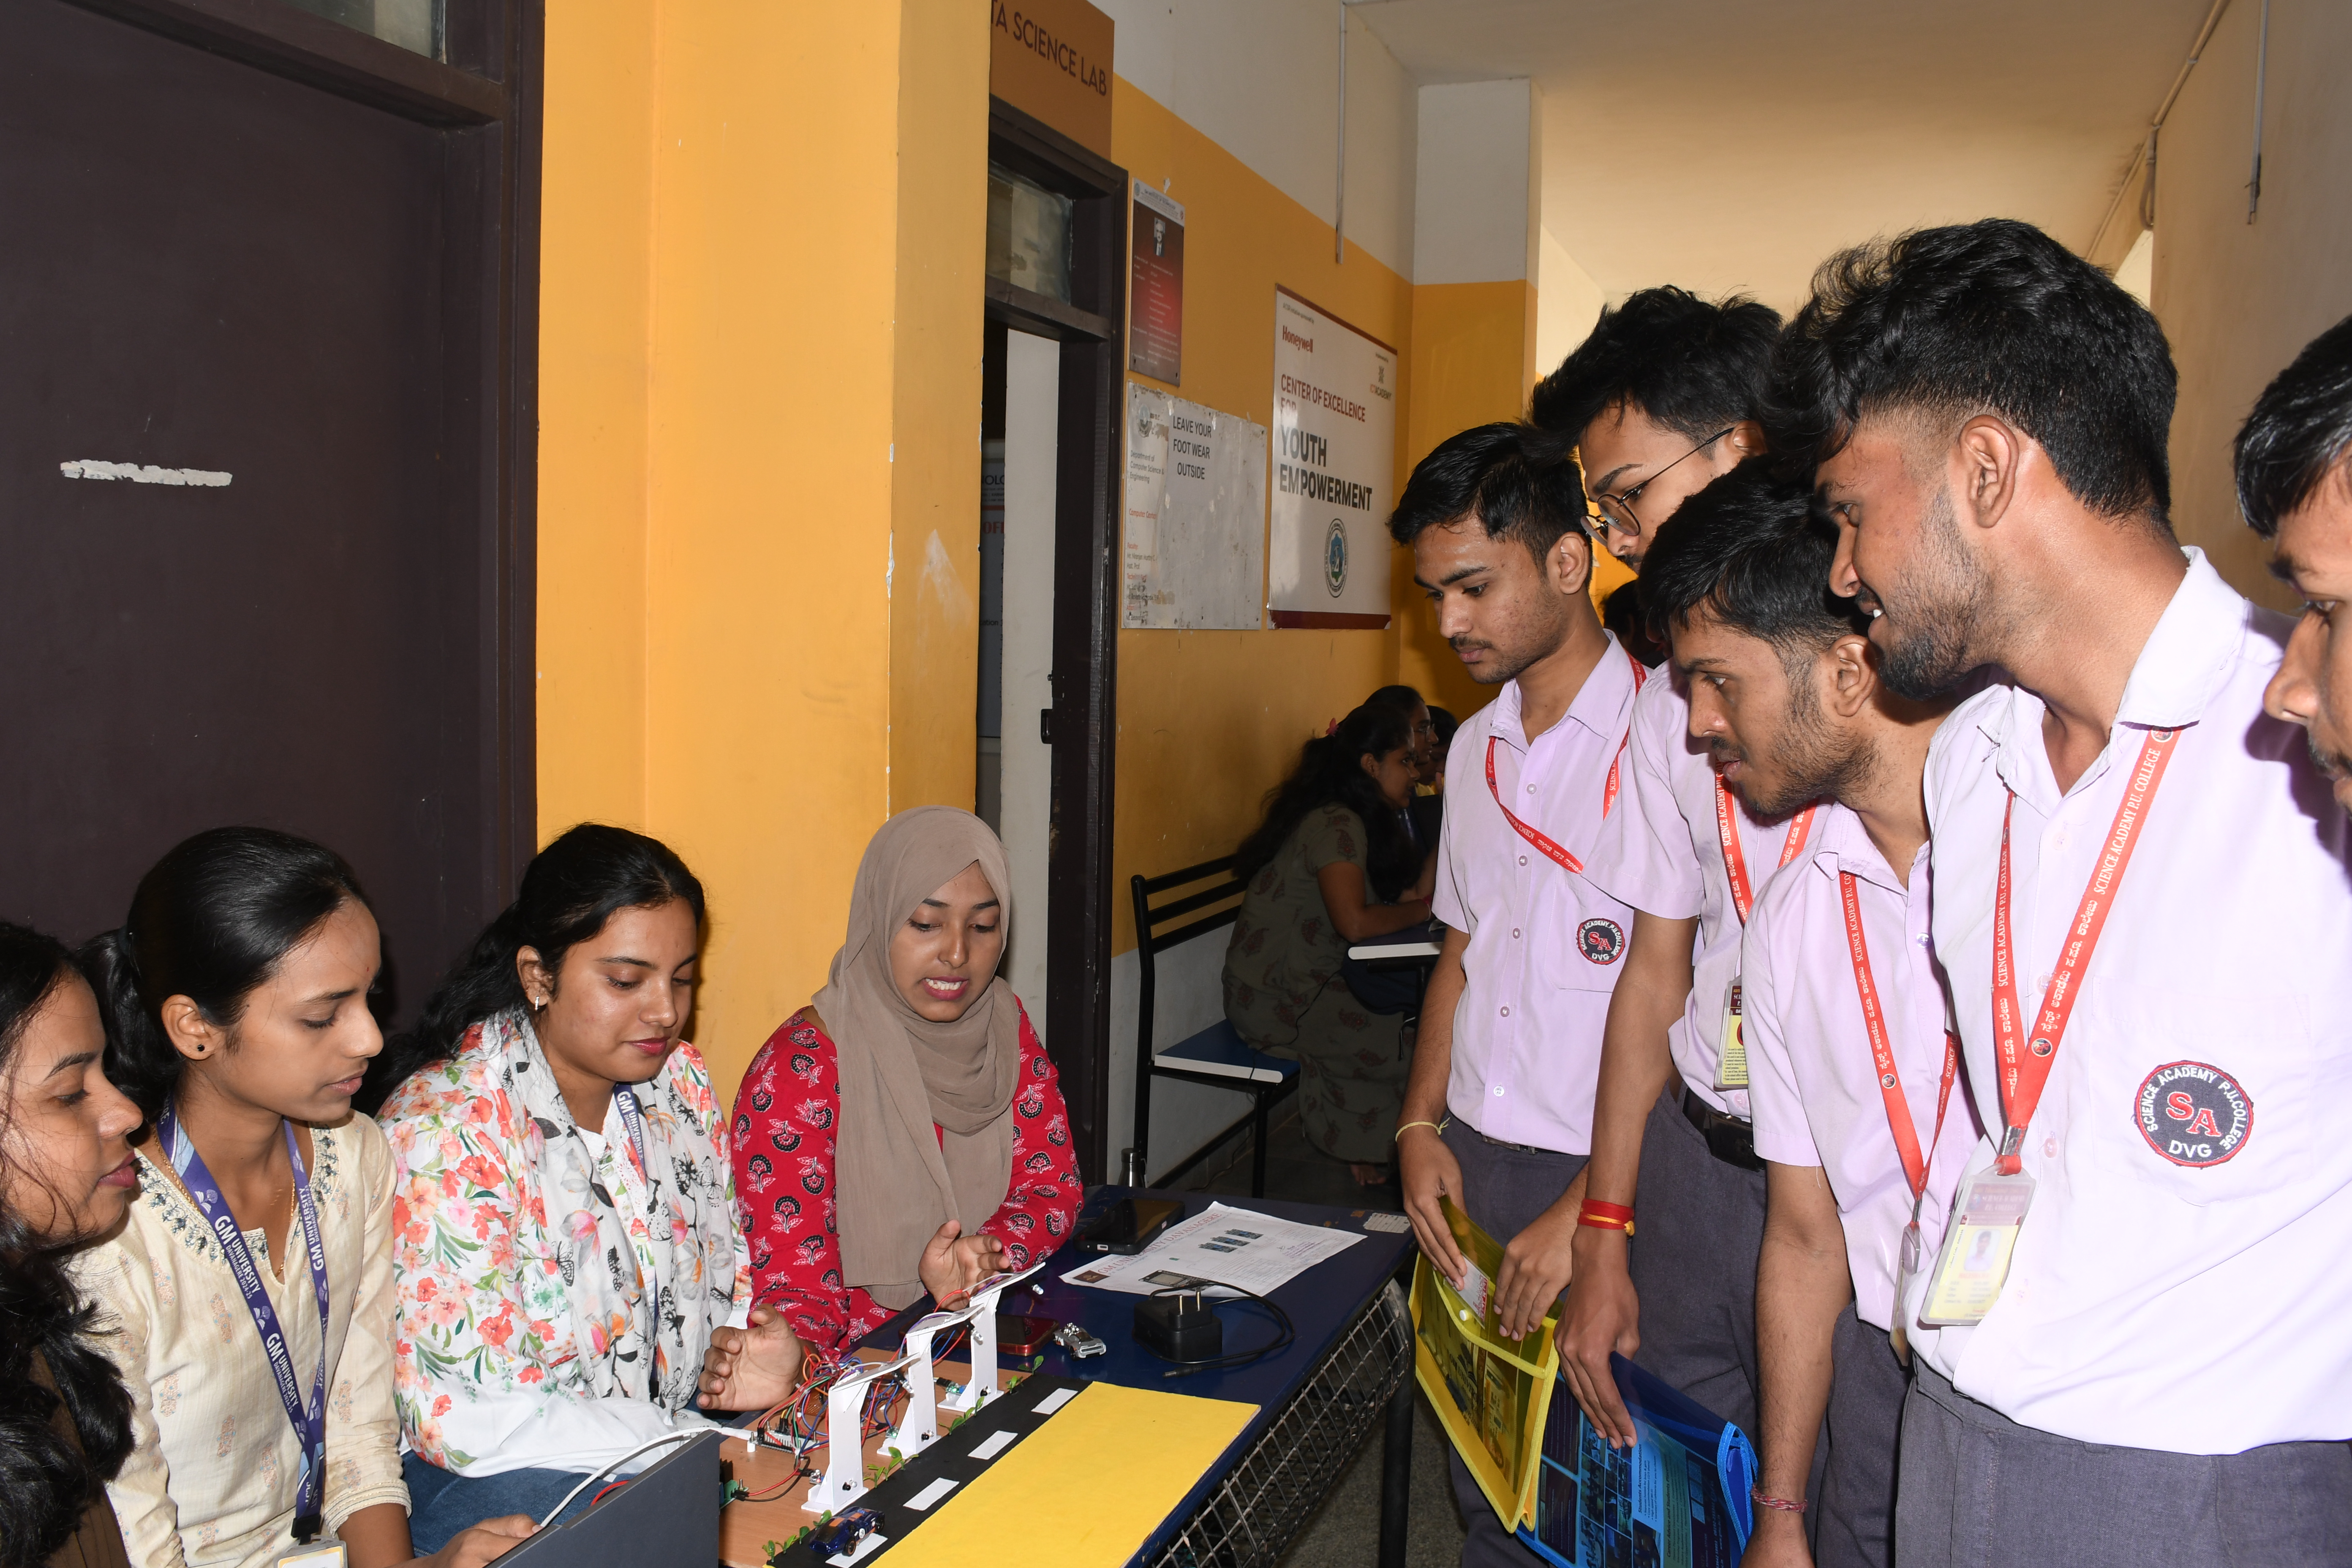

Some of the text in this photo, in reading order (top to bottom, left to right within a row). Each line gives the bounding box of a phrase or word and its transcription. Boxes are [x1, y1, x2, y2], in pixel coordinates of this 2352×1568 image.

[1013, 11, 1077, 78] SCIENCE
[1081, 56, 1107, 96] LAB
[1282, 325, 1313, 353] Honeywell
[1281, 374, 1365, 422] CENTER OF EXCELLENCE
[1173, 416, 1193, 433] LEAVE
[1195, 422, 1212, 438] YOUR
[1173, 438, 1210, 459] FOOT WEAR
[1281, 424, 1327, 467] YOUTH
[1177, 462, 1205, 480] OUTSIDE
[1279, 463, 1372, 511] EMPOWERMENT
[1716, 788, 1726, 820] ACADEMY
[2094, 748, 2161, 895] SCIENCE ACADEMY P.U. COLLEGE
[1518, 825, 1535, 839] SCIENCE
[1720, 819, 1732, 846] SCIENCE
[1584, 920, 1609, 930] ACADEMY
[1847, 900, 1858, 931] ACADEMY
[1997, 907, 2006, 947] ACADEMY
[1851, 931, 1864, 962] SCIENCE
[1998, 948, 2008, 987] SCIENCE
[1945, 1046, 1956, 1079] SCIENCE
[2142, 1084, 2159, 1132] SCIENCE
[2158, 1067, 2217, 1086] ACADEMY
[617, 1091, 644, 1159] GM UNIVERSITY
[2168, 1140, 2212, 1158] DVG
[299, 1187, 324, 1271] GM UNIVERSITY
[1097, 1262, 1116, 1274] GM
[1164, 1212, 1222, 1242] DAVANAGERE
[215, 1215, 261, 1293] GM UNIVERSITY
[226, 1244, 245, 1279] DAVANAGERE
[267, 1333, 299, 1407] GM UNIVERSITY
[273, 1361, 288, 1394] DAVANAGERE
